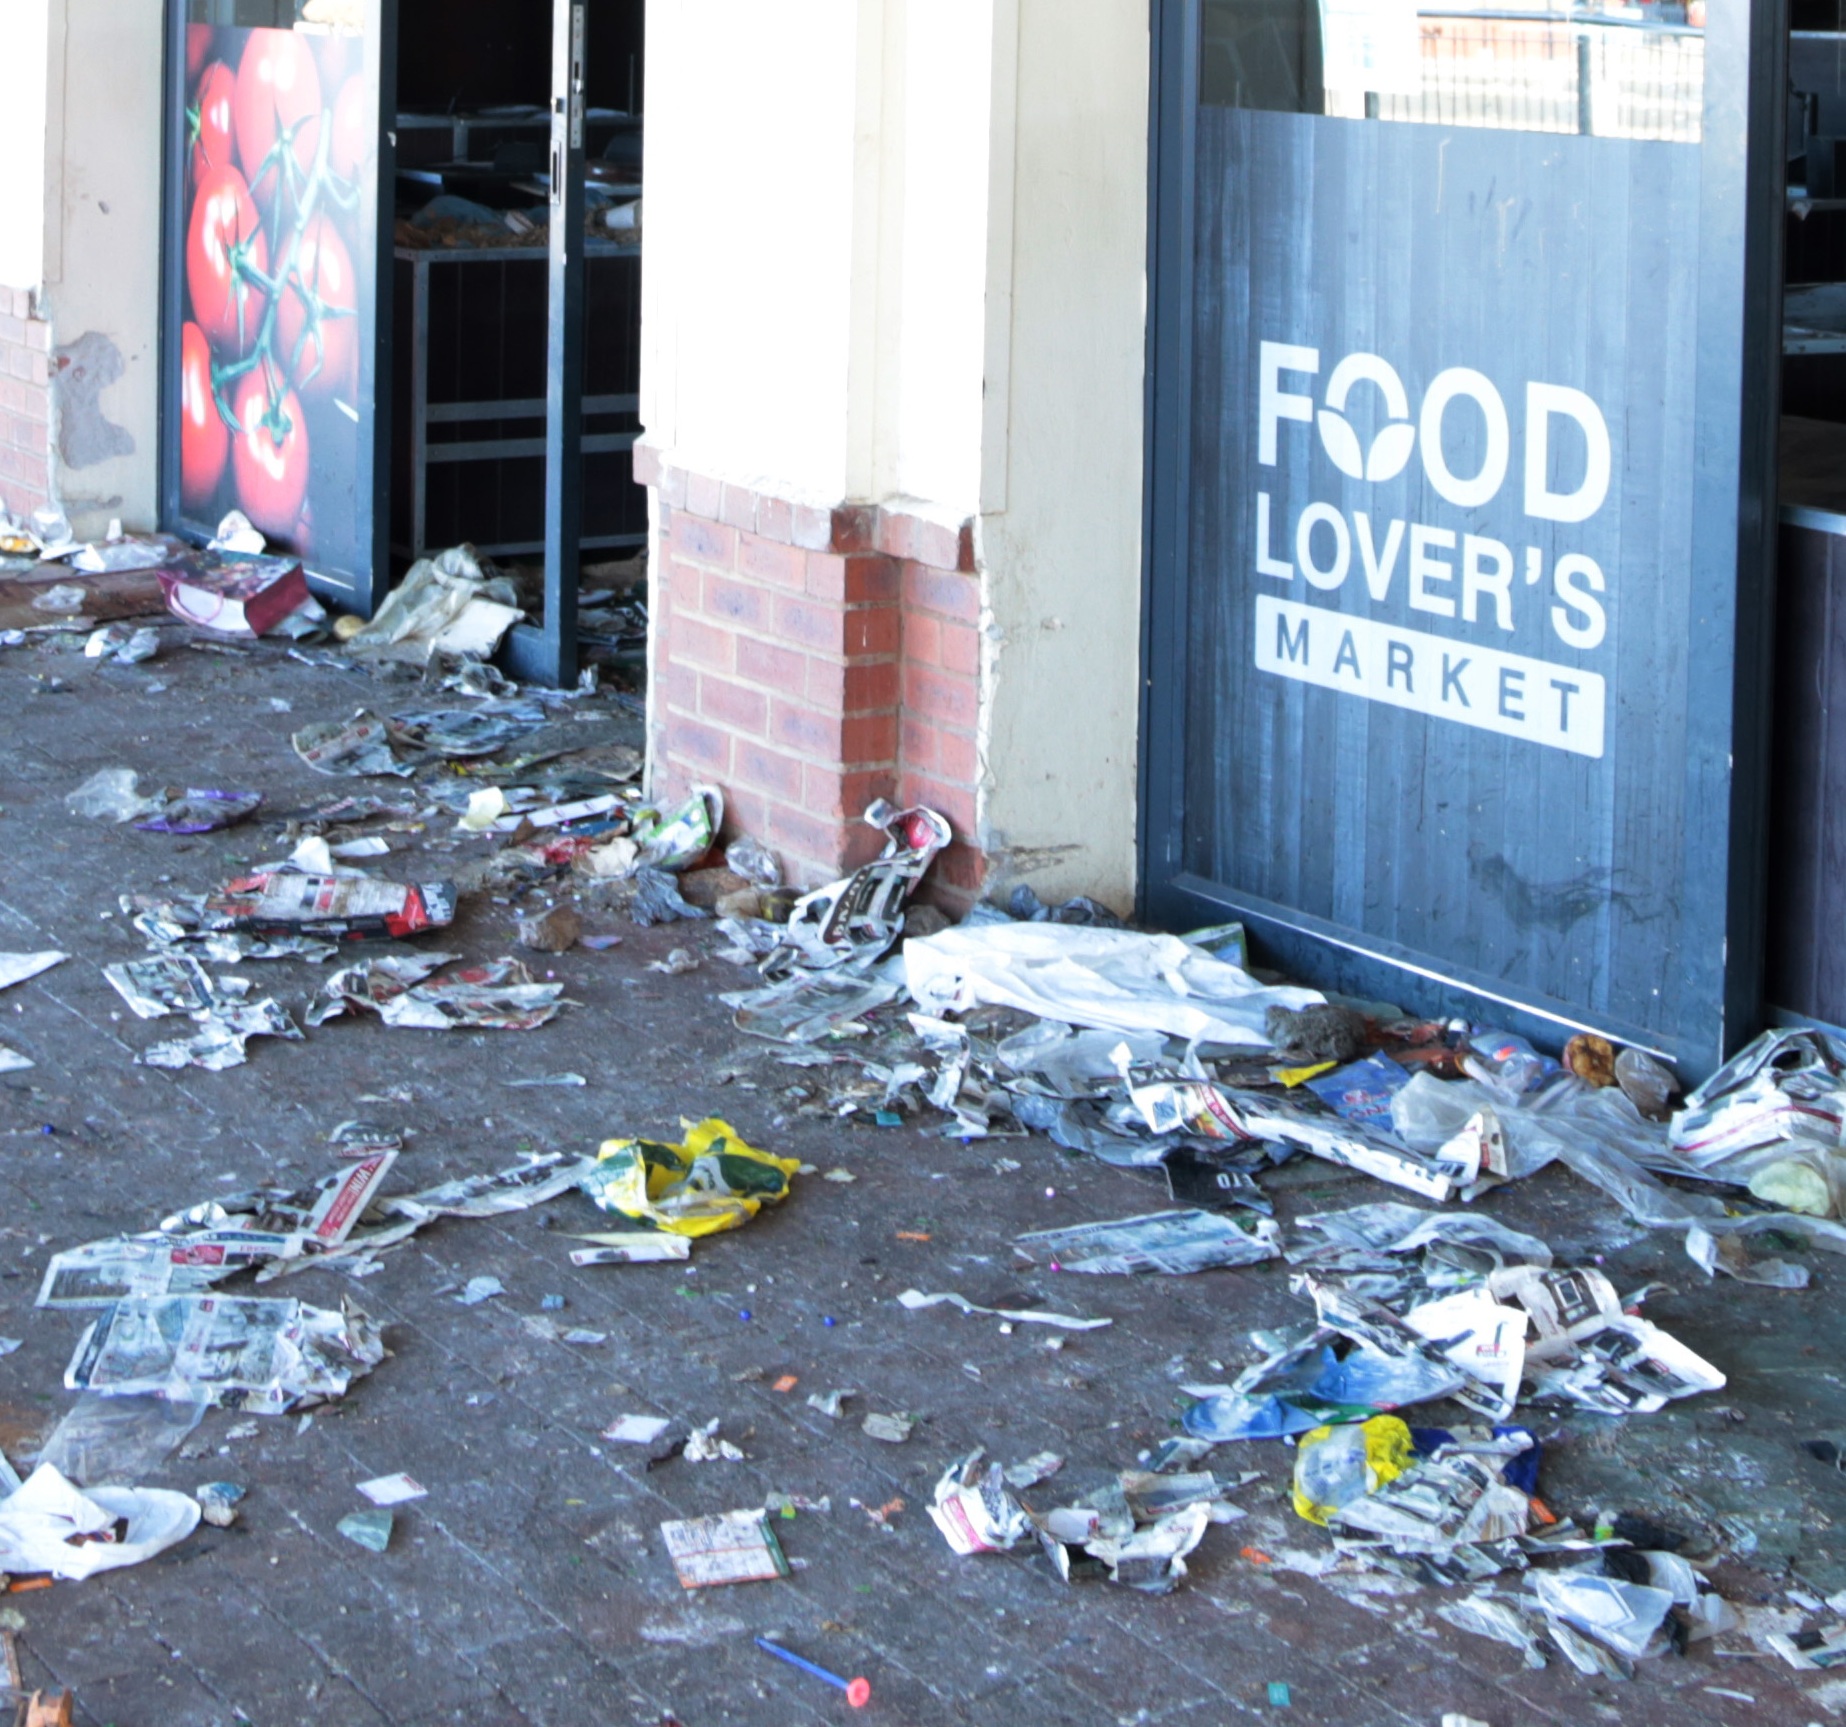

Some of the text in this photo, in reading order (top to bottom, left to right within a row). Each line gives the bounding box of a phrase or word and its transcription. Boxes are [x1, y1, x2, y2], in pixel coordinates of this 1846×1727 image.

[1258, 340, 1611, 523] FOOD
[1256, 492, 1607, 650] LOVER'S
[1275, 612, 1580, 734] MARKET
